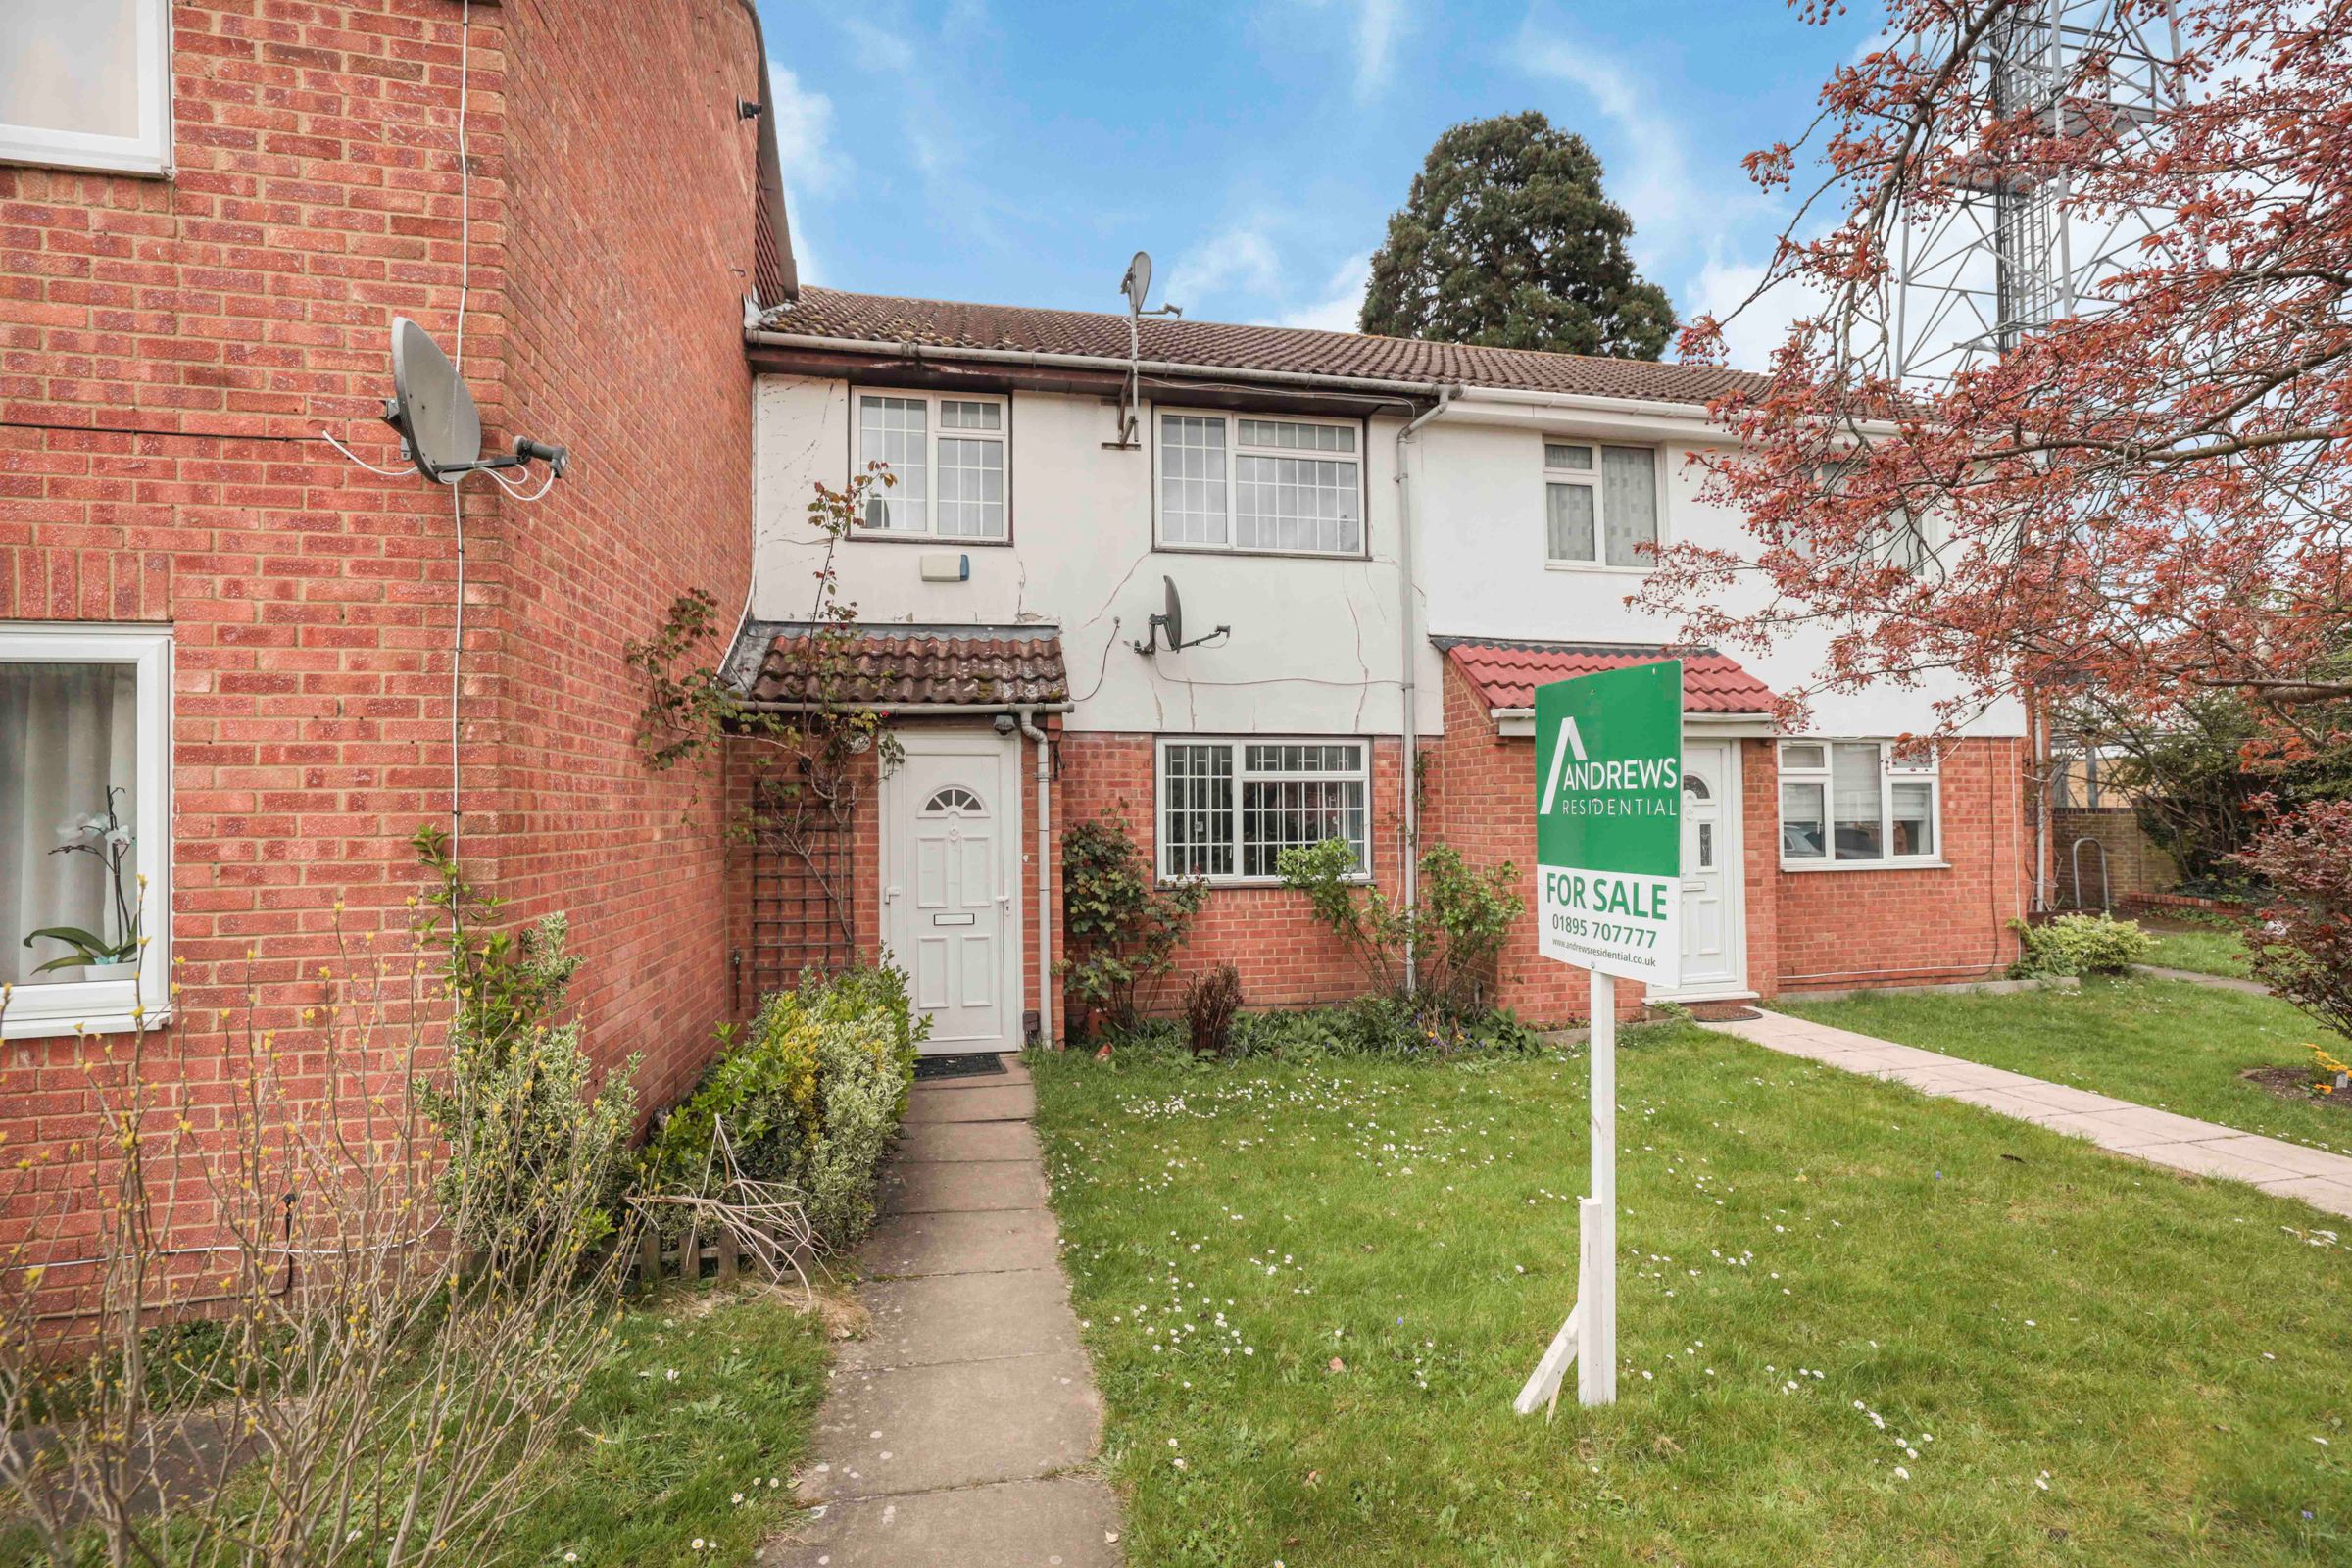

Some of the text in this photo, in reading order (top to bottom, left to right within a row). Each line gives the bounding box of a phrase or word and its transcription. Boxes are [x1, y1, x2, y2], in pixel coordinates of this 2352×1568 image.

[1563, 758, 1677, 791] ANDREWS
[1563, 798, 1677, 815] RESIDENTIAL
[1547, 872, 1667, 920] FOR SALE
[1552, 913, 1657, 949] 01895 707777
[1552, 938, 1656, 967] www.andrewsresidential.co.uk
